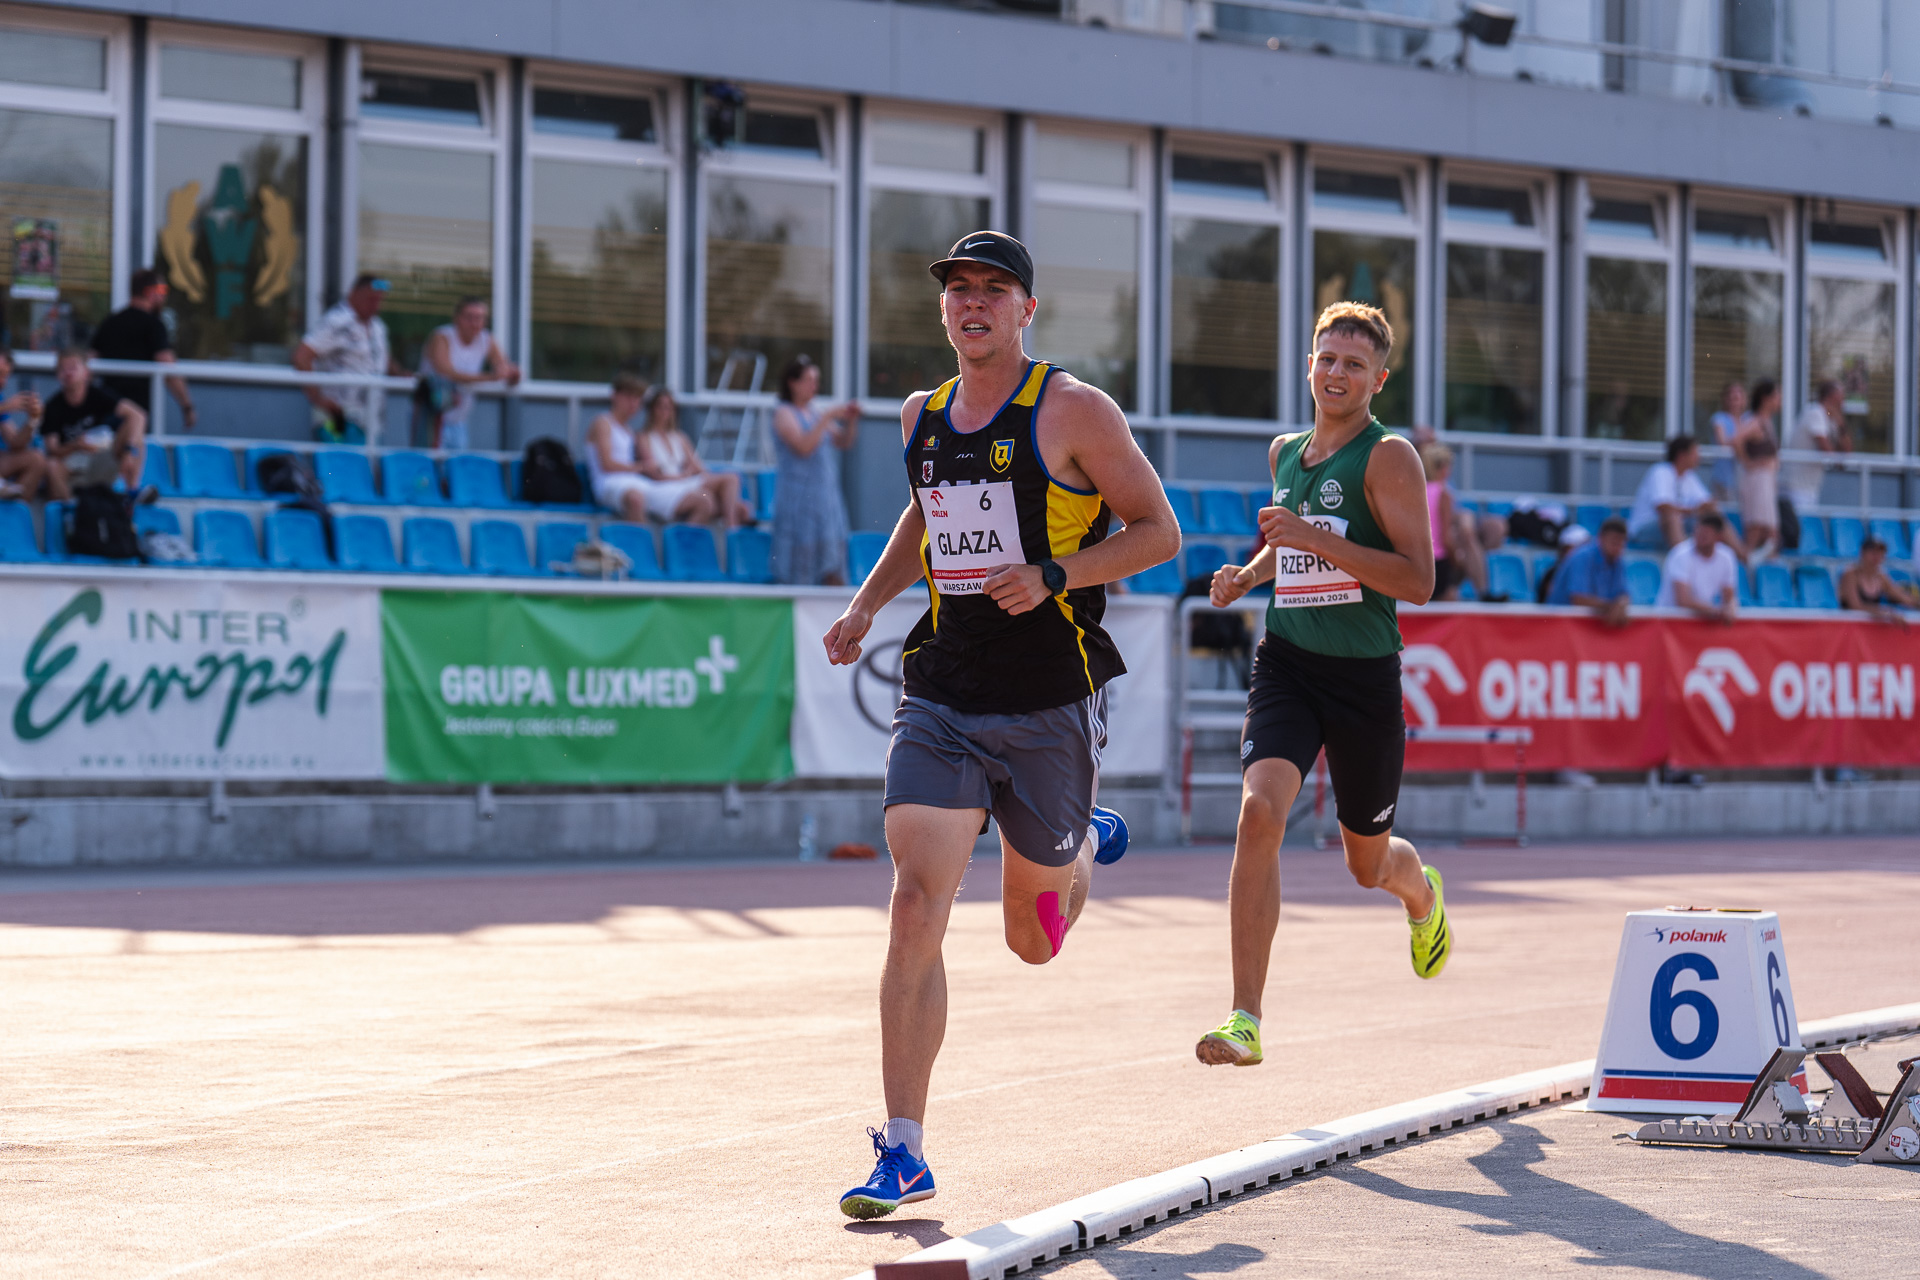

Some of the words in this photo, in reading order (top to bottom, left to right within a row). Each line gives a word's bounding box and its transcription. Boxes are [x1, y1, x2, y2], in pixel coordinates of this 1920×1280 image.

[980, 490, 992, 511] 6
[938, 530, 1004, 555] GLAZA
[1281, 555, 1337, 575] RZEPK
[942, 581, 982, 592] WARSZAW
[1282, 596, 1325, 604] WARSZAWA
[1327, 593, 1349, 602] 2026
[128, 610, 290, 644] INTER
[13, 587, 347, 750] Europol
[440, 664, 556, 706] GRUPA
[567, 667, 698, 708] LUXMED
[1479, 659, 1640, 719] ORLEN
[1770, 661, 1915, 720] ORLEN
[1669, 928, 1728, 944] polanik
[1650, 952, 1720, 1061] 6
[1767, 950, 1791, 1047] 6
